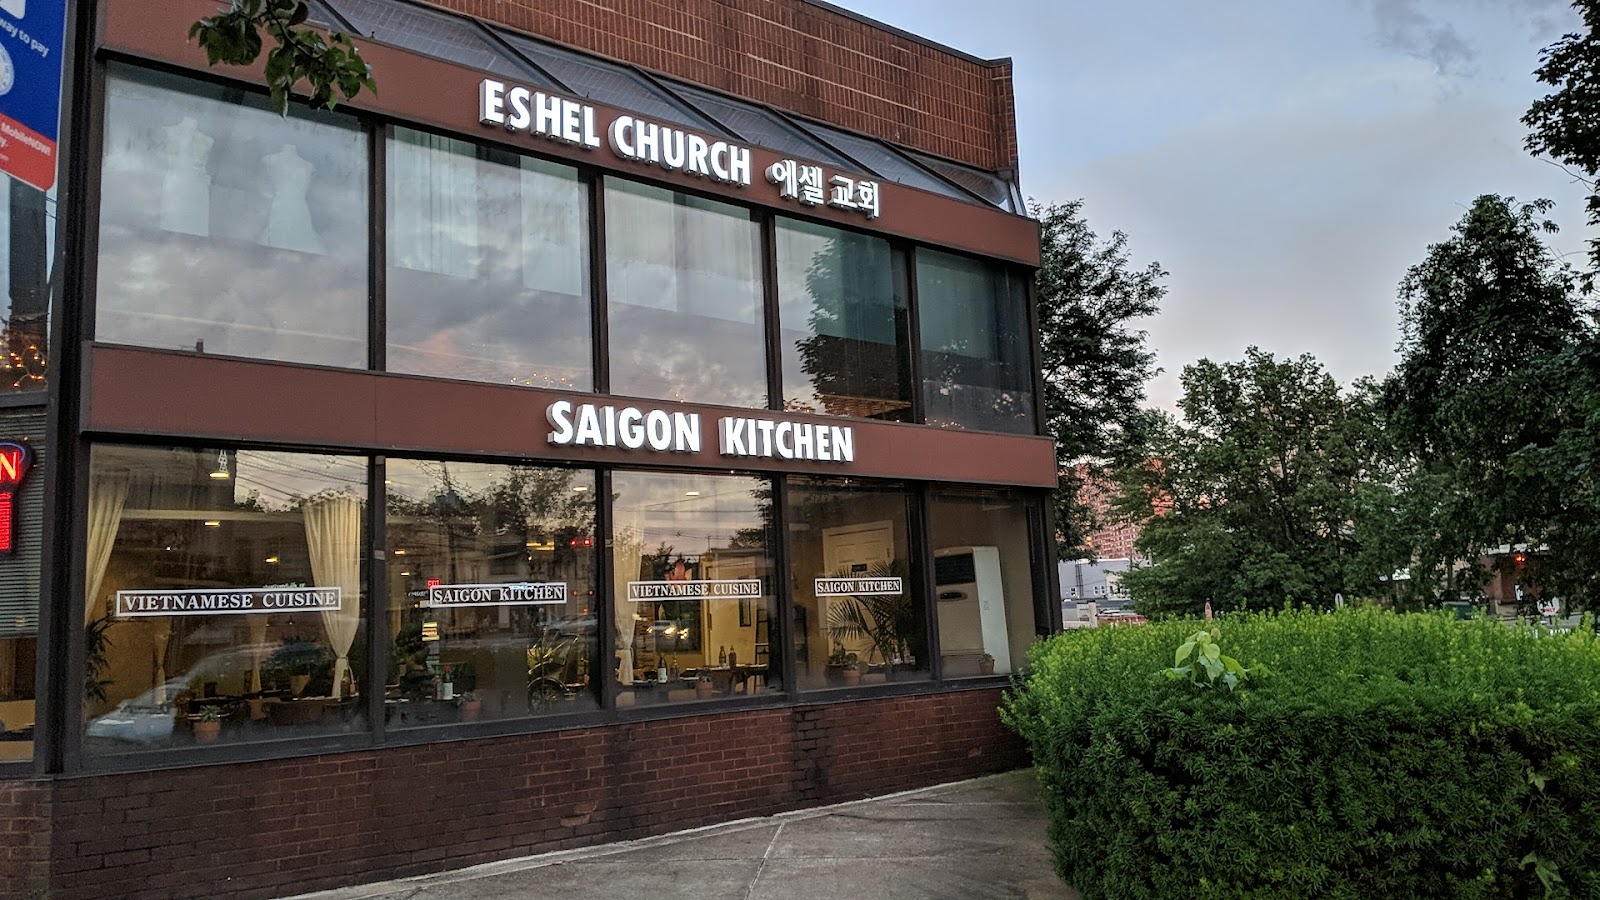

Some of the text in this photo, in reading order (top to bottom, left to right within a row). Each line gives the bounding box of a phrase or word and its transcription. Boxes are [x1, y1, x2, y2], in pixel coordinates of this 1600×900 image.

[19, 30, 31, 44] to
[31, 39, 50, 58] pay
[479, 78, 752, 187] ESHEL CHURCH
[766, 159, 881, 219] 에셀 교회
[547, 400, 855, 463] SAIGON KITCHEN
[433, 588, 493, 603] SAIGON
[499, 586, 564, 601] KITCHEN
[631, 582, 759, 598] VIETNAMESE CUISINE
[817, 580, 900, 593] SAIGON KITCHEN
[124, 592, 336, 611] VIETNAMESE CUISINE
